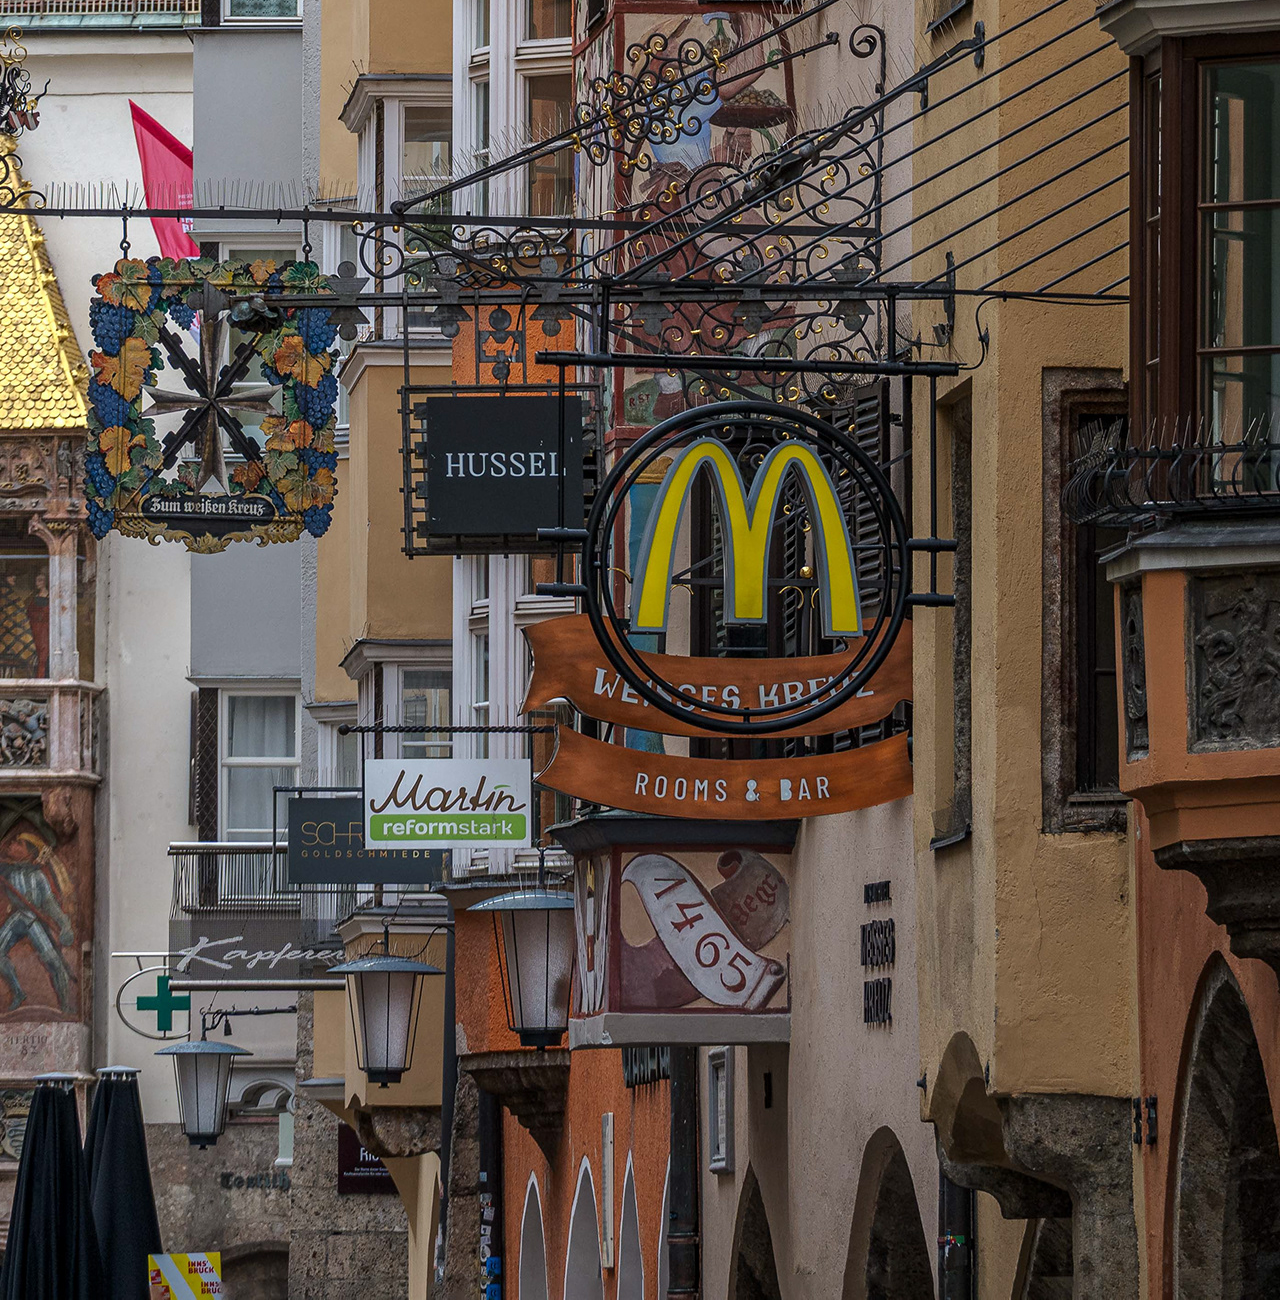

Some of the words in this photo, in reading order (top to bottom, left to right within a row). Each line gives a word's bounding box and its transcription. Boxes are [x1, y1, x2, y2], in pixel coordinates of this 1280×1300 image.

[445, 452, 567, 477] HUSSEL
[150, 498, 181, 513] Zum
[184, 499, 226, 515] weißen
[228, 499, 266, 516] Kreuz
[370, 769, 527, 813] Martin
[635, 772, 728, 802] ROOMS
[745, 779, 760, 802] &
[780, 776, 830, 801] BAR
[383, 819, 513, 836] reformstark
[301, 850, 431, 858] GOLDSCHMIEDE
[652, 876, 753, 993] 1465
